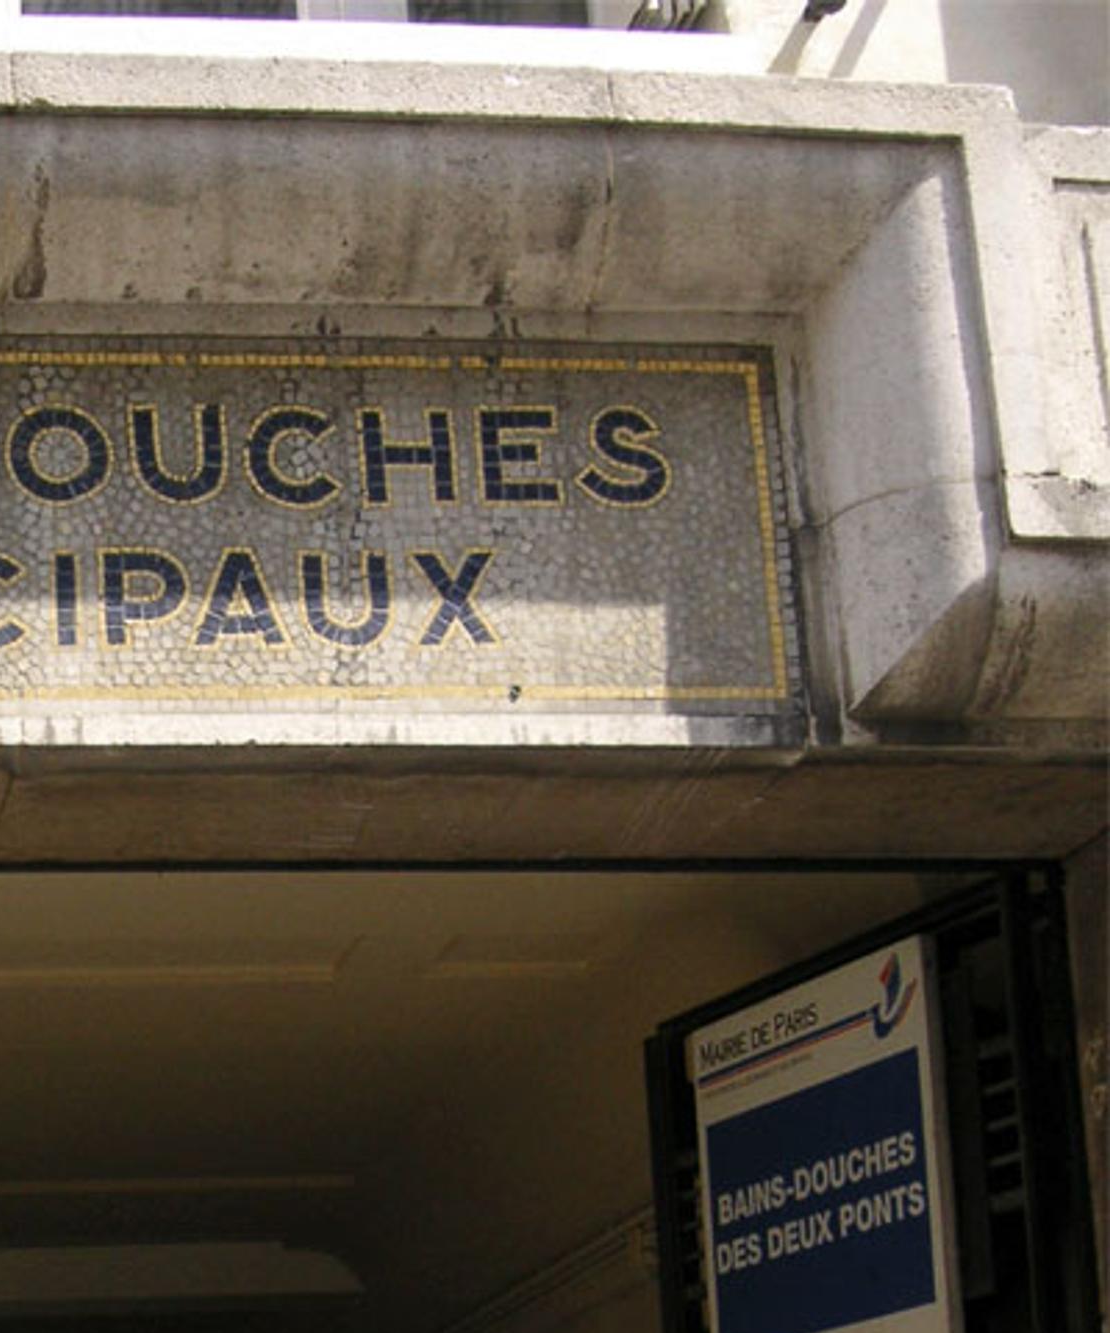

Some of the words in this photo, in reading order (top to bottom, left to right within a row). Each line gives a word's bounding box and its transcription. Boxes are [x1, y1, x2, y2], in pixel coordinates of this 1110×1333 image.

[750, 1021, 772, 1050] DE
[774, 1002, 820, 1039] PARIS
[717, 1131, 917, 1226] BAINS-DOUCHES
[716, 1231, 763, 1275] DES
[768, 1214, 834, 1259] DEUX
[839, 1181, 926, 1237] PONTS
